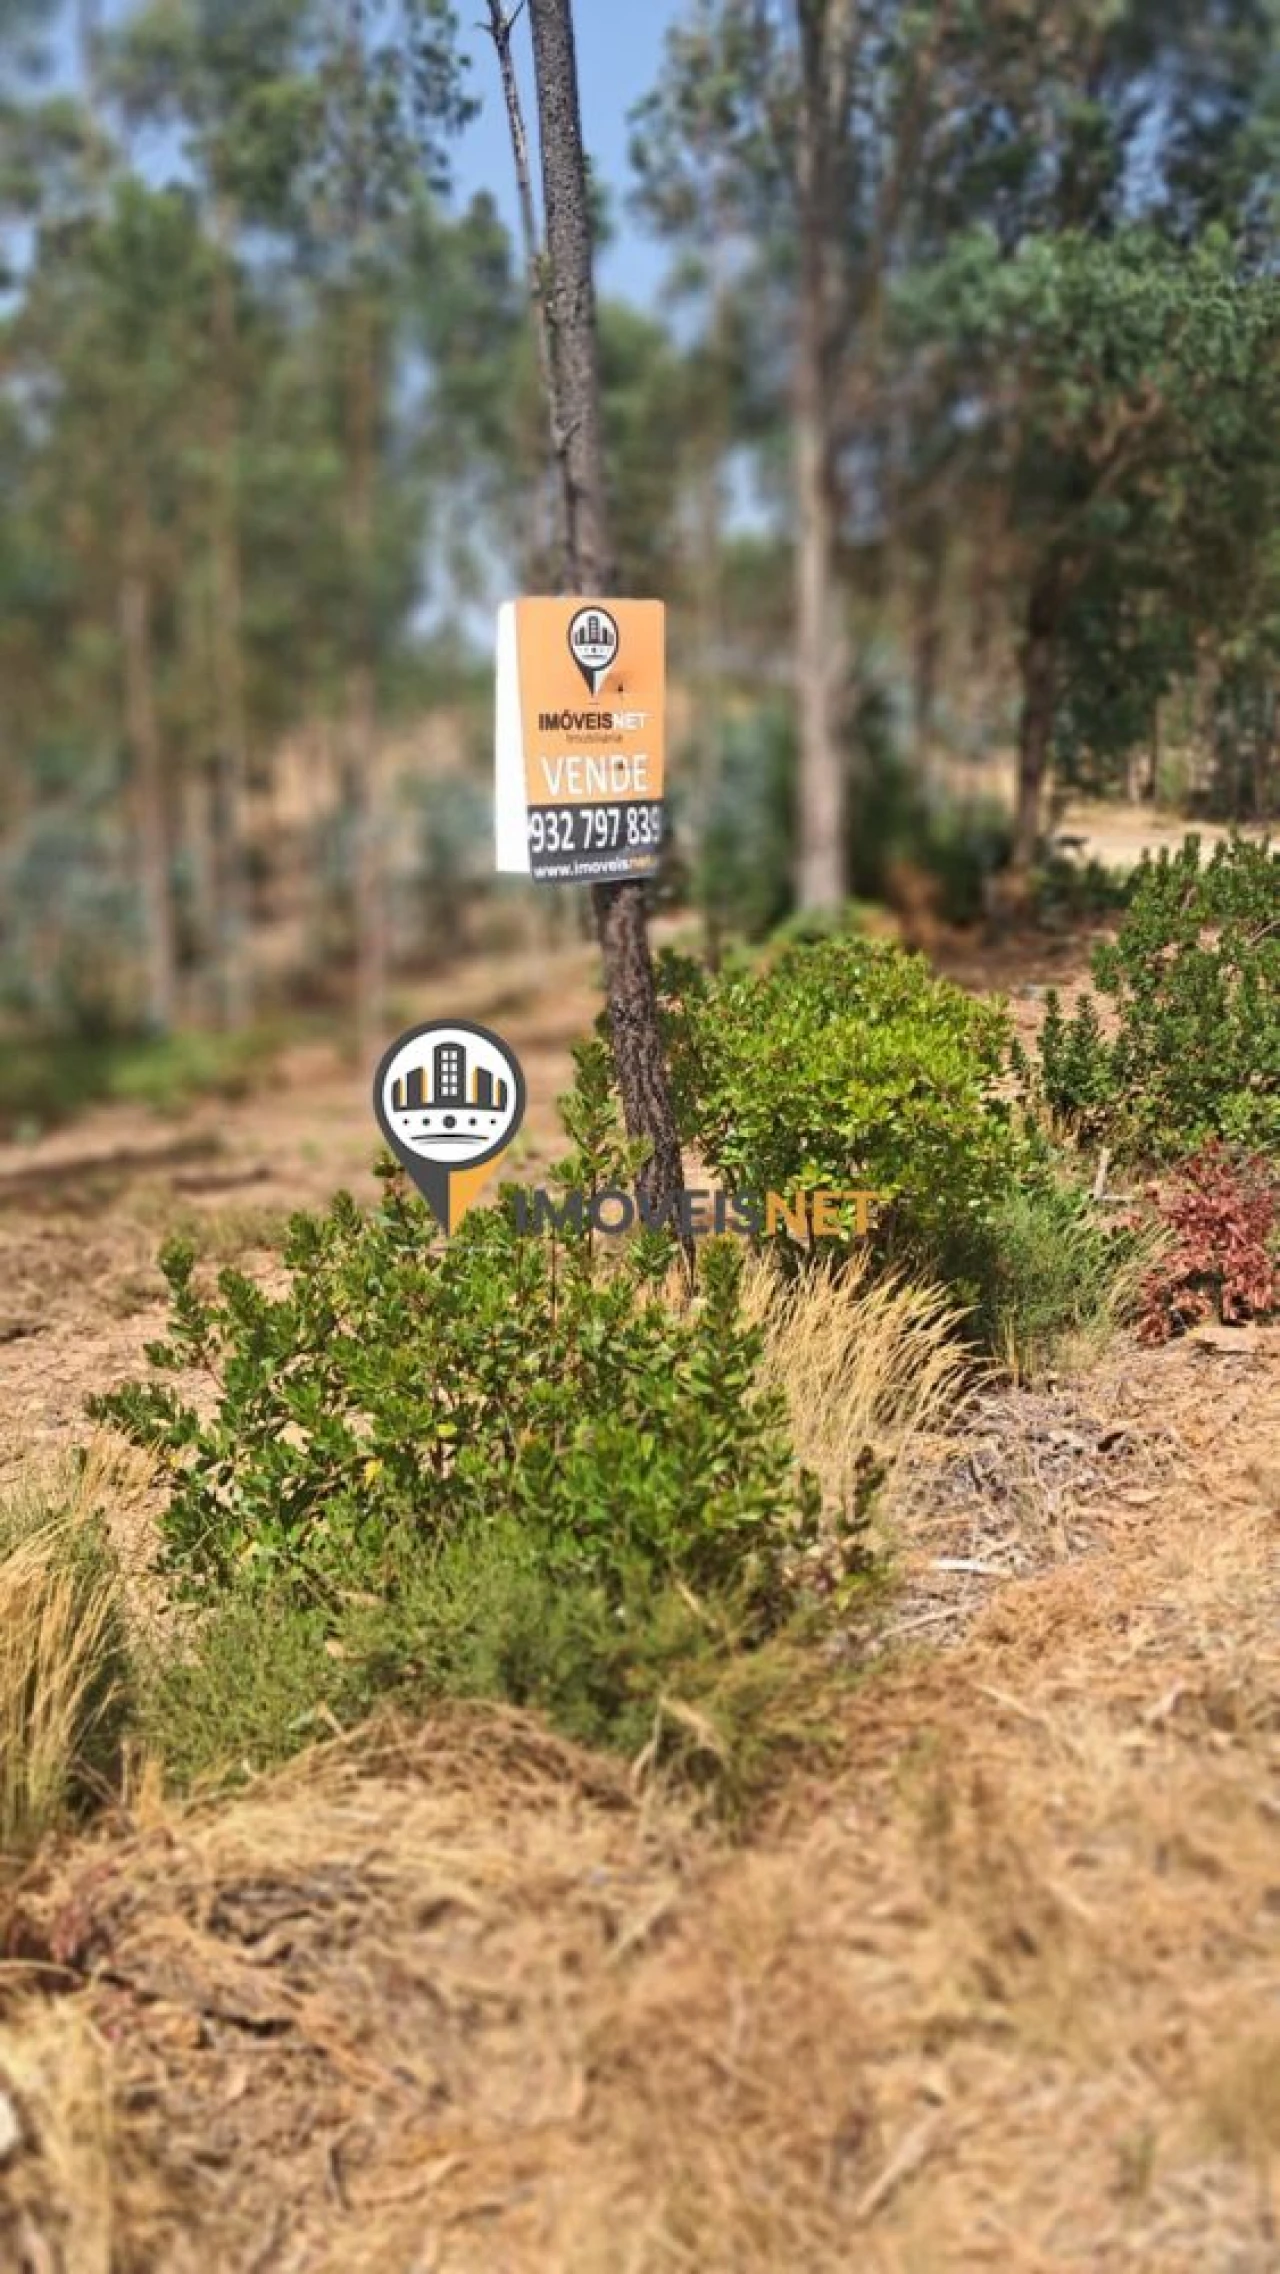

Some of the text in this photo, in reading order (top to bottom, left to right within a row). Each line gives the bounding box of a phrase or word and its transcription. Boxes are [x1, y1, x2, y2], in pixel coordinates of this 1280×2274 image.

[540, 755, 649, 796] VENDE
[531, 810, 575, 853] 932
[579, 808, 620, 850] 797
